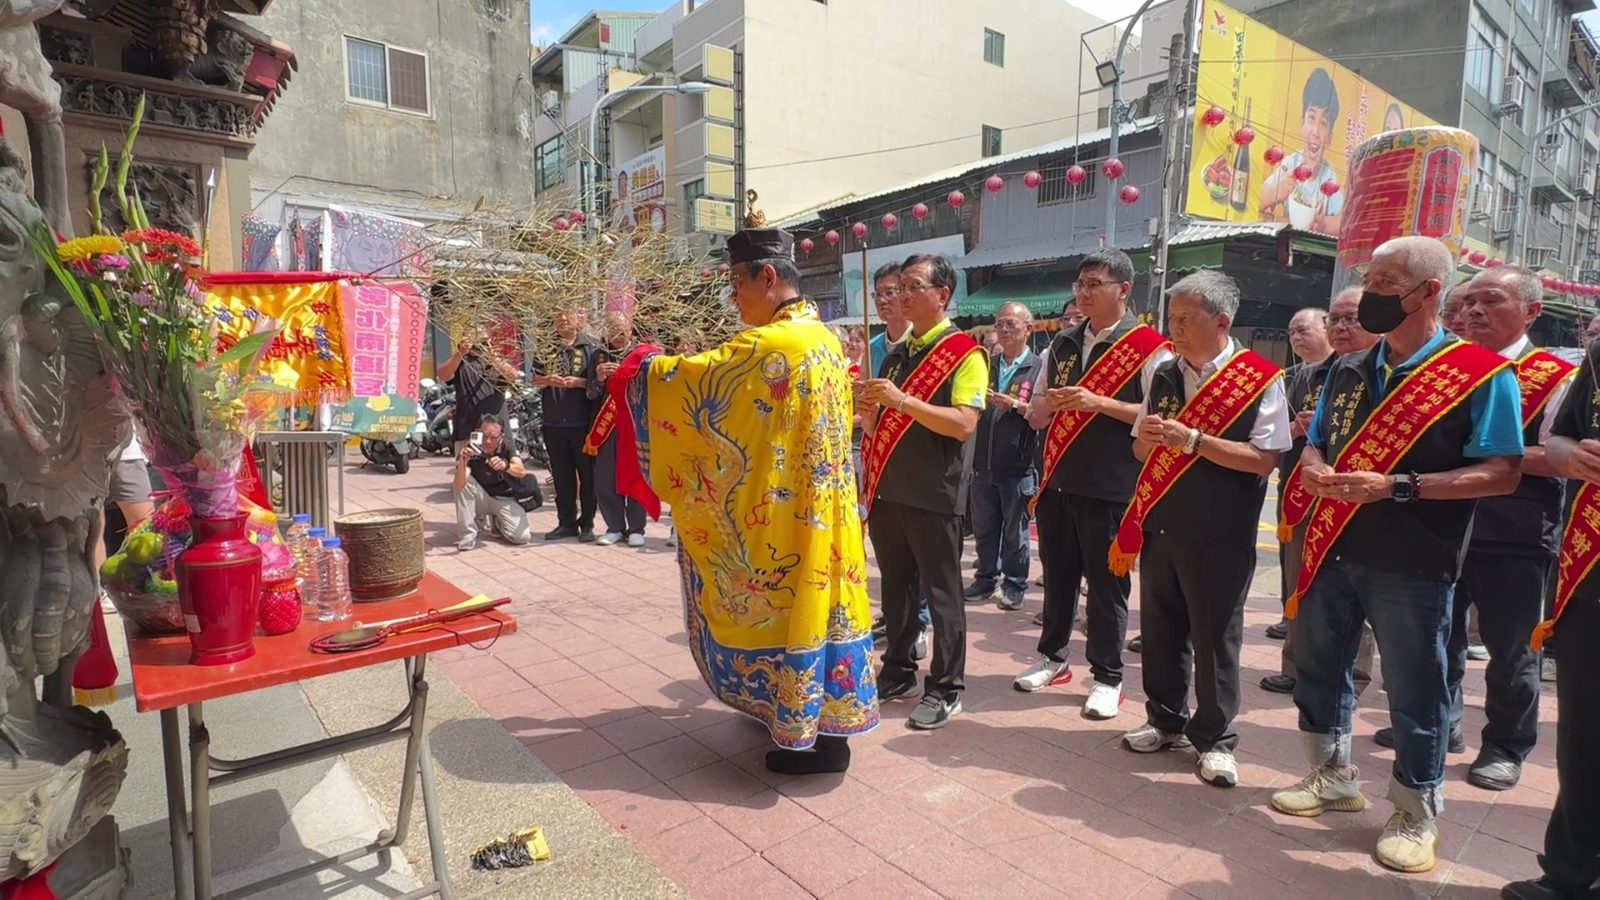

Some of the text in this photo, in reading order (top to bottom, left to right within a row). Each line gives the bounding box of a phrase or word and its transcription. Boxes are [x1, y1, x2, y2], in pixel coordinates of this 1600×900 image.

[1420, 369, 1457, 399] 南瑤宮
[1436, 363, 1470, 385] 丙午年
[1396, 390, 1445, 435] 開基三媽
